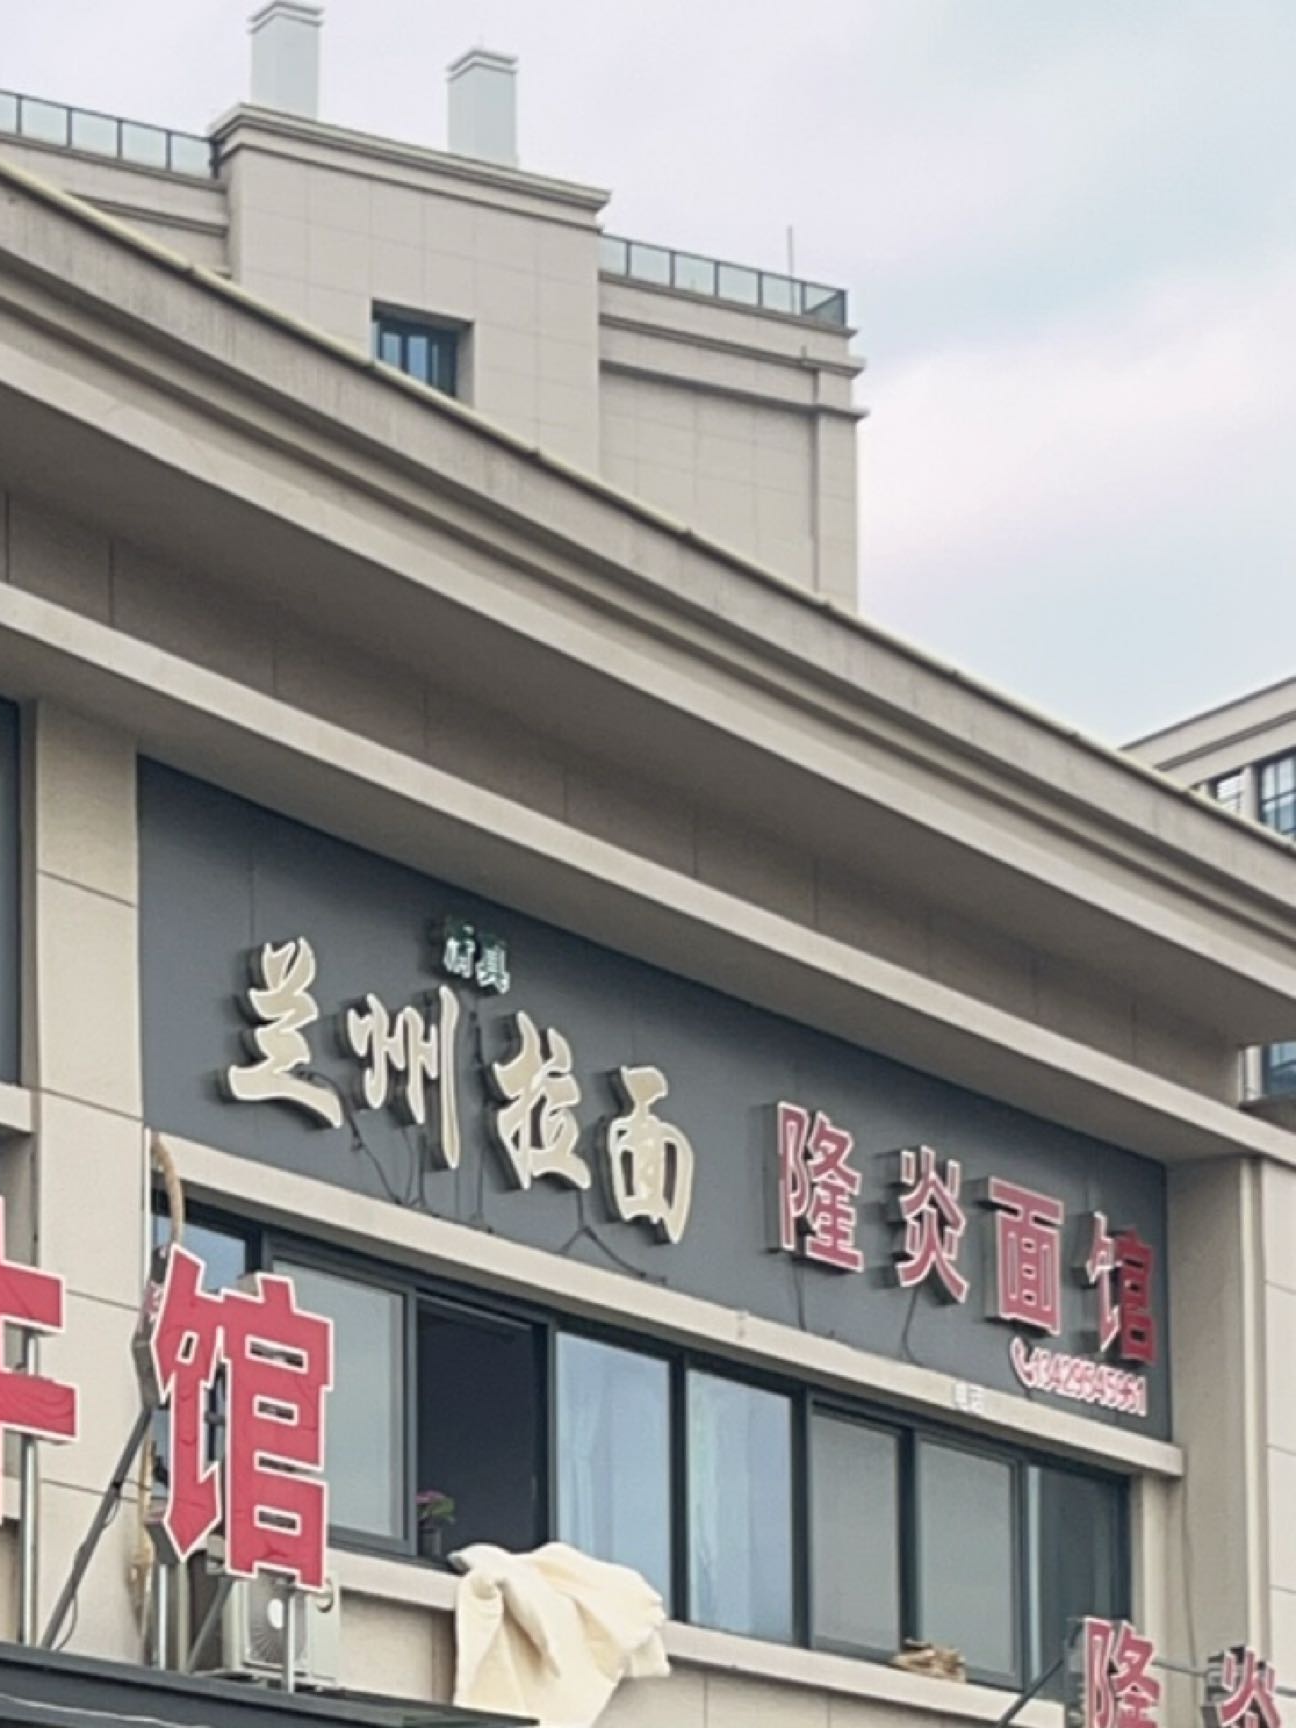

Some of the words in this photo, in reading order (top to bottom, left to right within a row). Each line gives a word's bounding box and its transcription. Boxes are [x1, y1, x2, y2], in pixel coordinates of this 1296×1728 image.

[229, 937, 694, 1244] 兰州拉面
[777, 1102, 1157, 1364] 隆炎面馆
